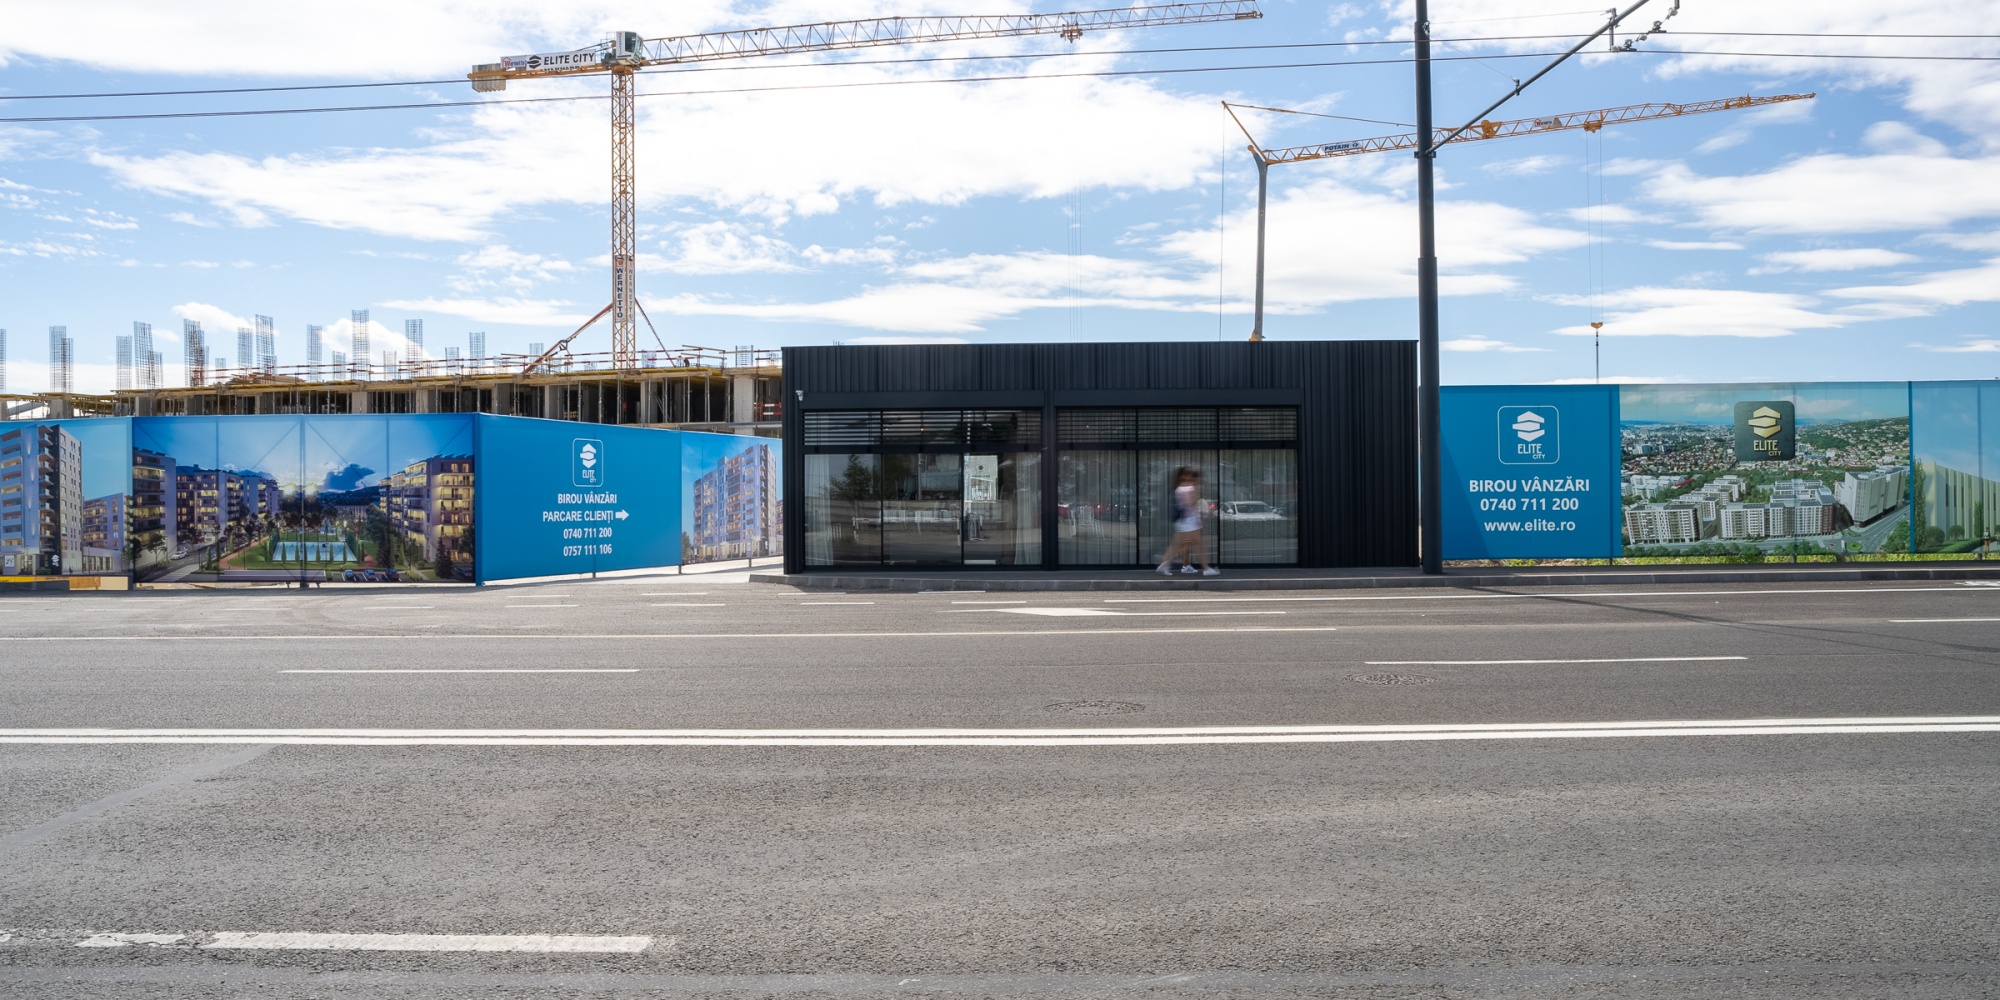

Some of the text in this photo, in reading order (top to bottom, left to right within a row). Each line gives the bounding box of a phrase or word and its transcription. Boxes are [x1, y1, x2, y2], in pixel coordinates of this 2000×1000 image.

[544, 53, 594, 65] ELITE CITY
[1517, 443, 1542, 454] ELITE
[1753, 440, 1778, 450] ELITE
[582, 470, 595, 478] ELITE
[1469, 476, 1590, 493] BIROU VÂNZĂRI
[558, 491, 617, 504] BIROU VÂNZĂRI
[1480, 498, 1579, 512] 0740 711 200
[543, 511, 582, 522] PARCARE
[1484, 519, 1576, 531] www.elite.ro
[563, 527, 612, 539] 0740 711 200
[563, 544, 612, 557] 0757 111 106
